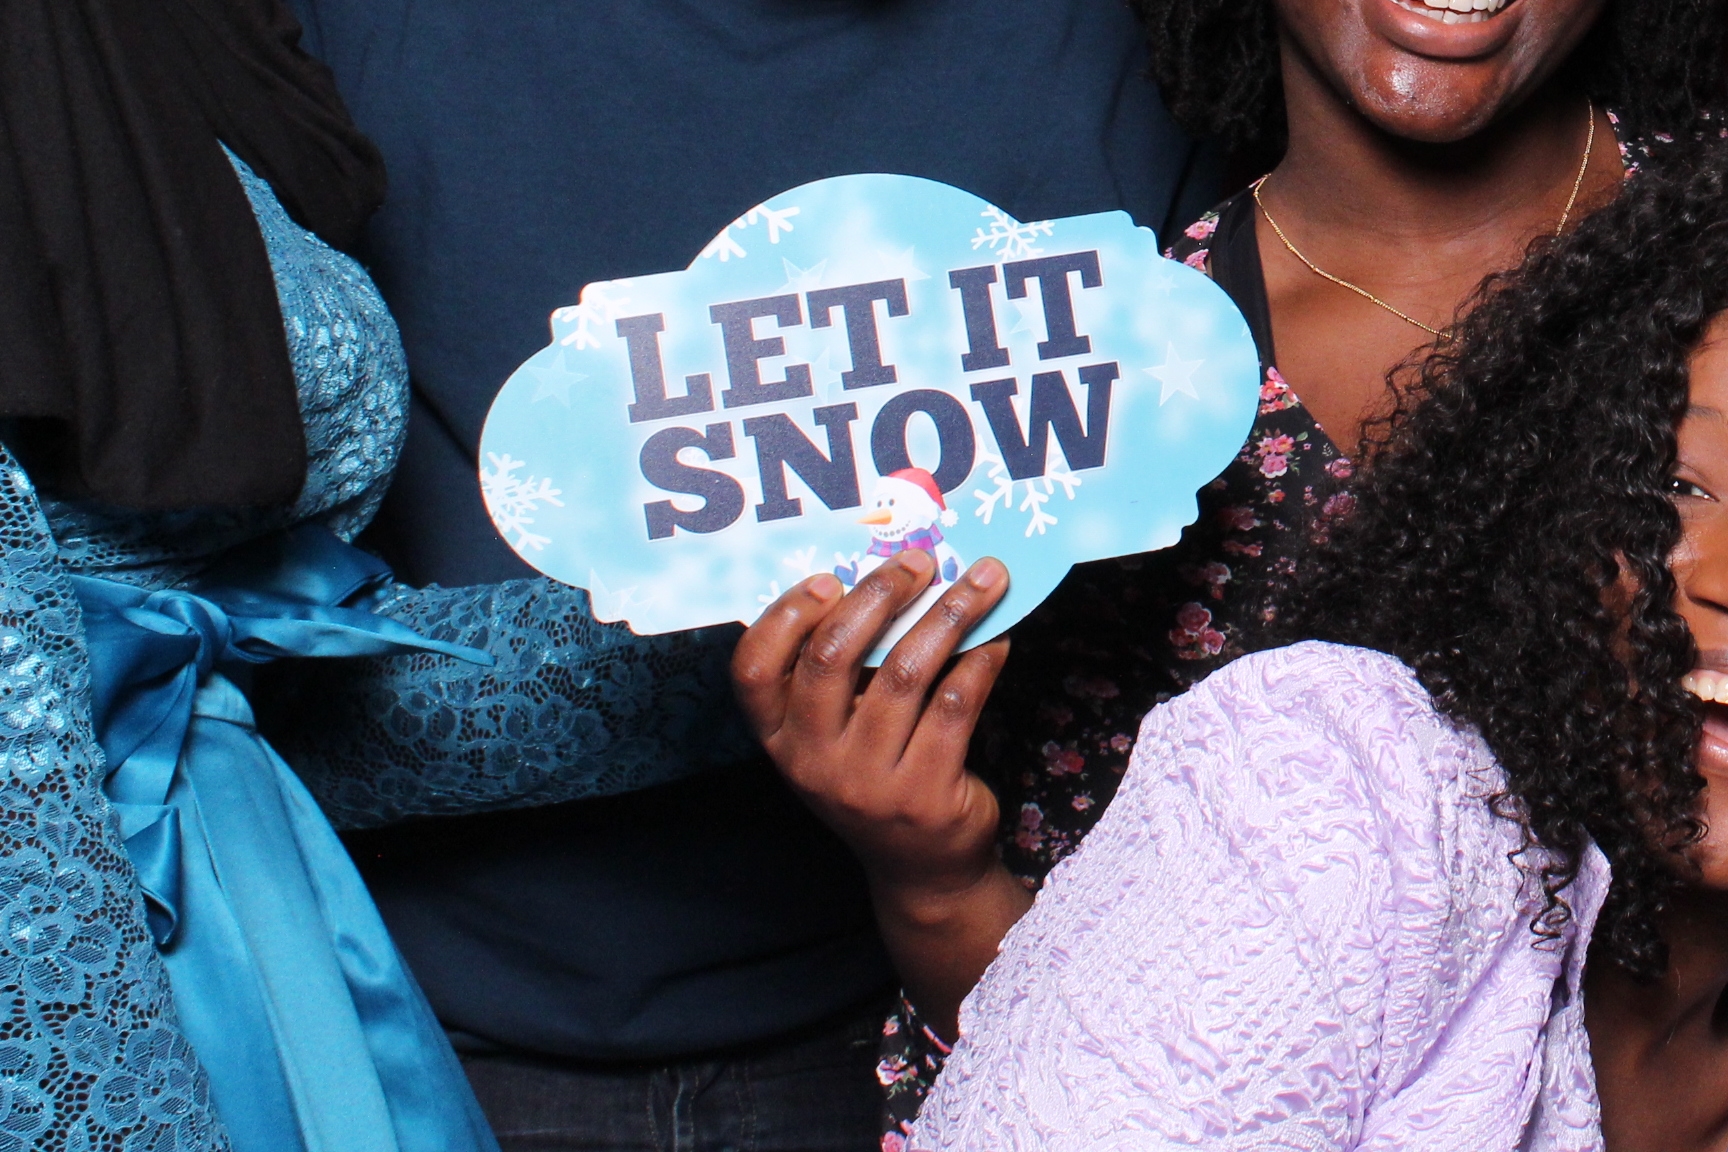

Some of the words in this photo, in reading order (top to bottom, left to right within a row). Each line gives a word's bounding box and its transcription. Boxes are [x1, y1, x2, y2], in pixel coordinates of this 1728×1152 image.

[615, 278, 911, 424] LET
[948, 250, 1104, 373] IT
[638, 361, 1120, 542] SNOW
